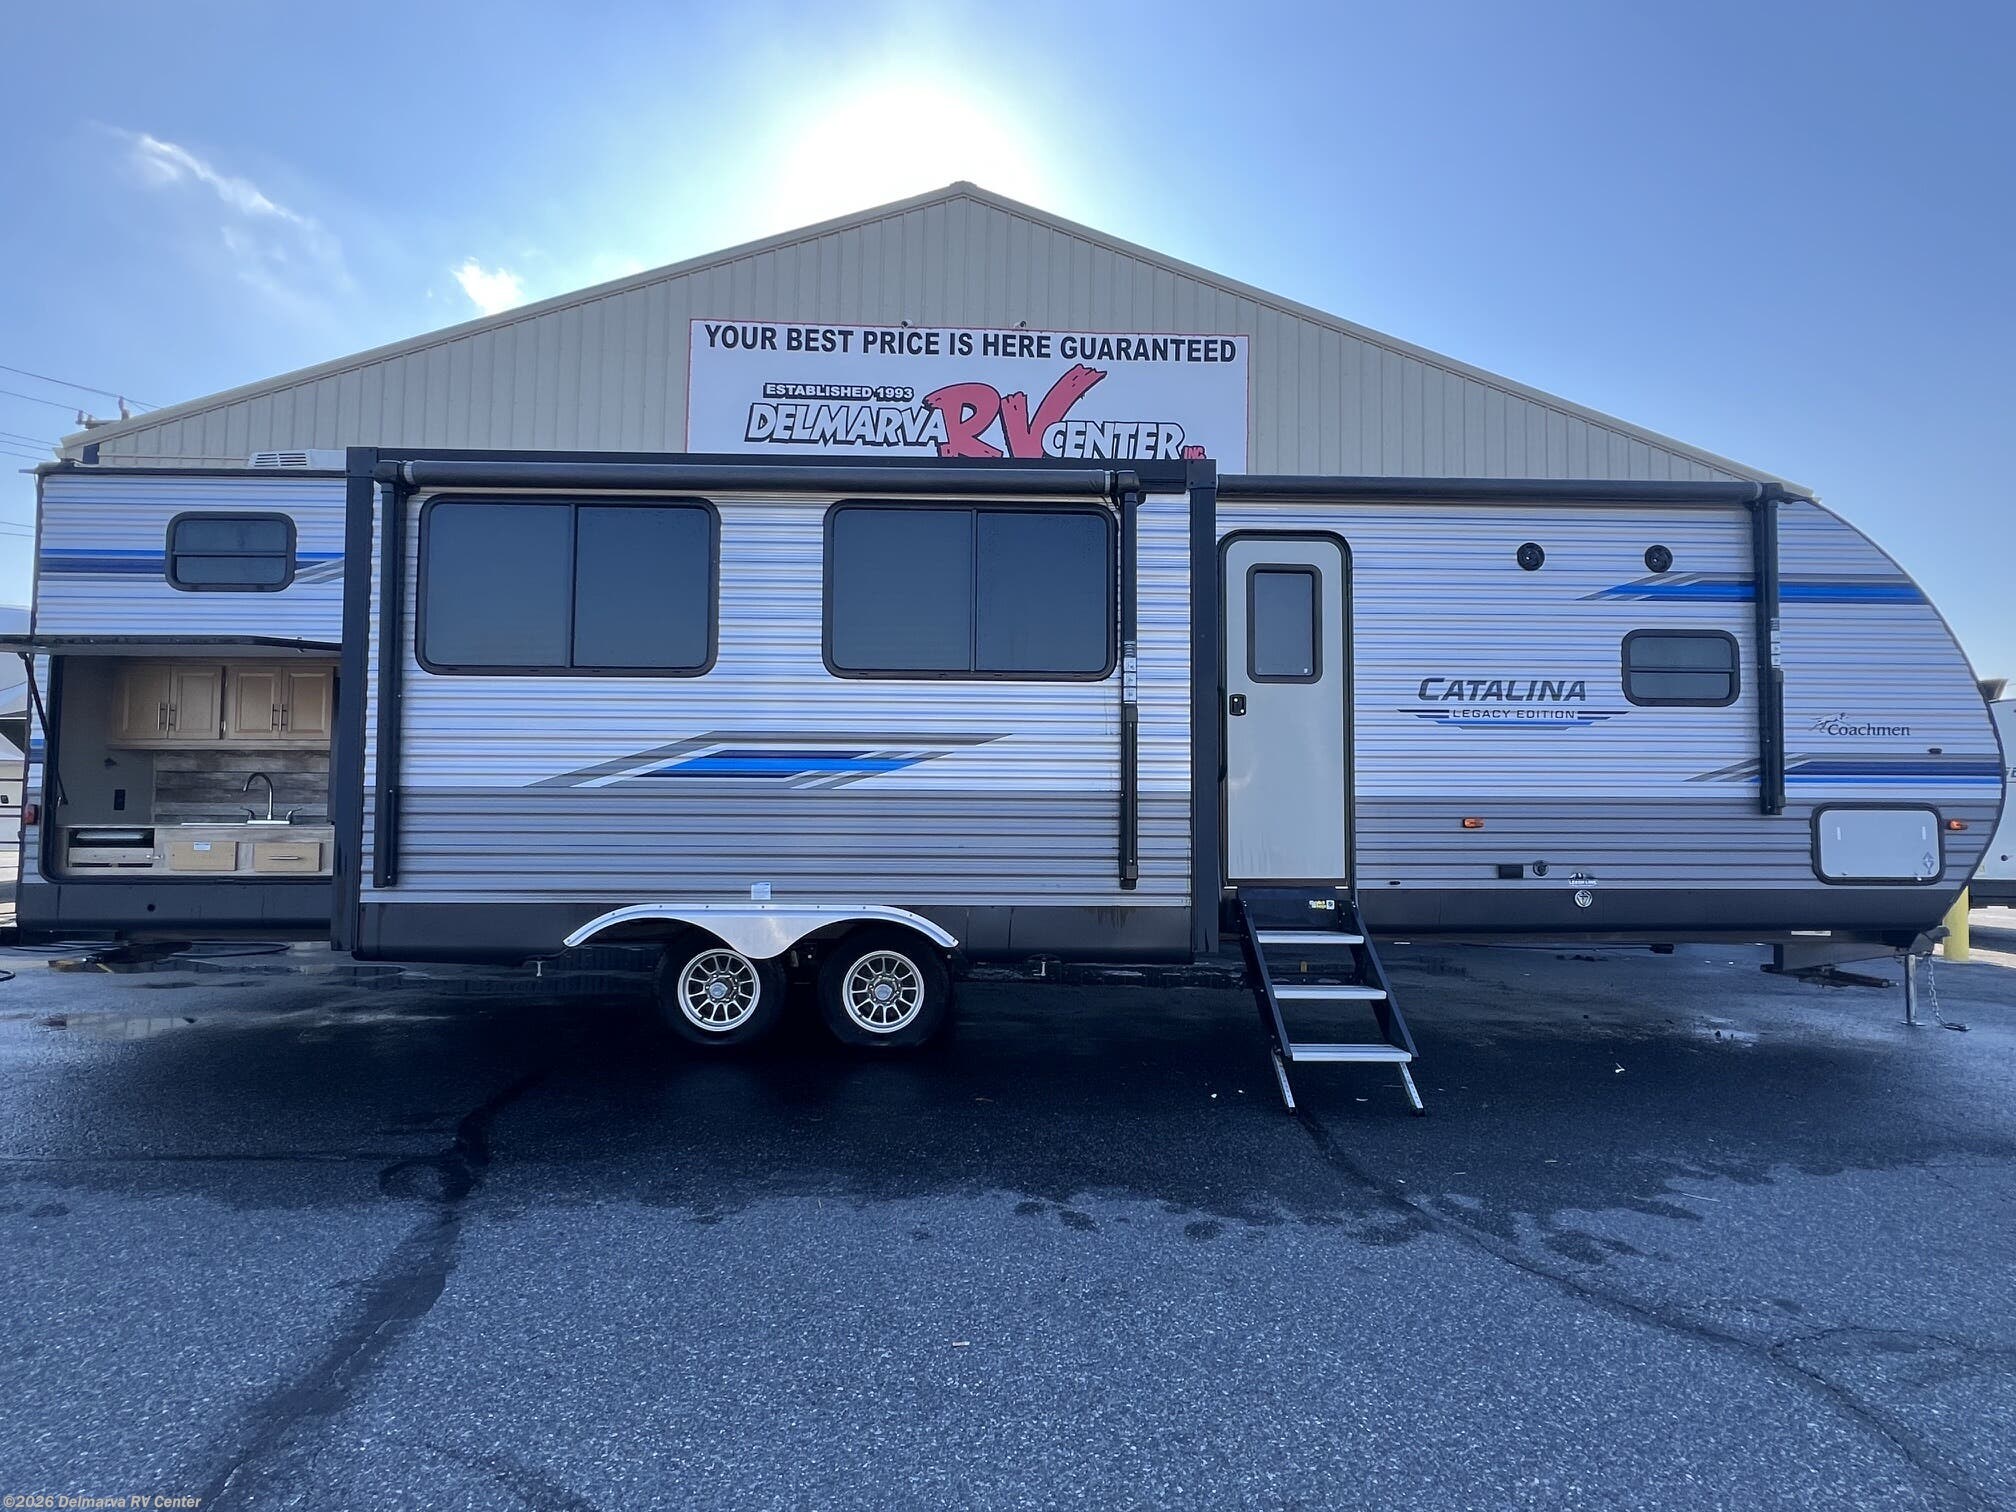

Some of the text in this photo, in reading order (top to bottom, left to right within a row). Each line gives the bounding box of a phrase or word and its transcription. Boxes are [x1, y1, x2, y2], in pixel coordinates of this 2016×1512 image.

[705, 324, 1237, 362] YOUR BEST PRICE IS HERE GUARANTEED
[765, 384, 914, 401] ESTABLISHED 1993
[745, 402, 950, 446] DELMARVA
[922, 363, 1108, 458] RV
[1043, 420, 1186, 460] CENTER
[1418, 677, 1587, 702] CATALINA
[1453, 709, 1576, 719] LEGACY EDITION
[1828, 723, 1910, 736] Coachmen
